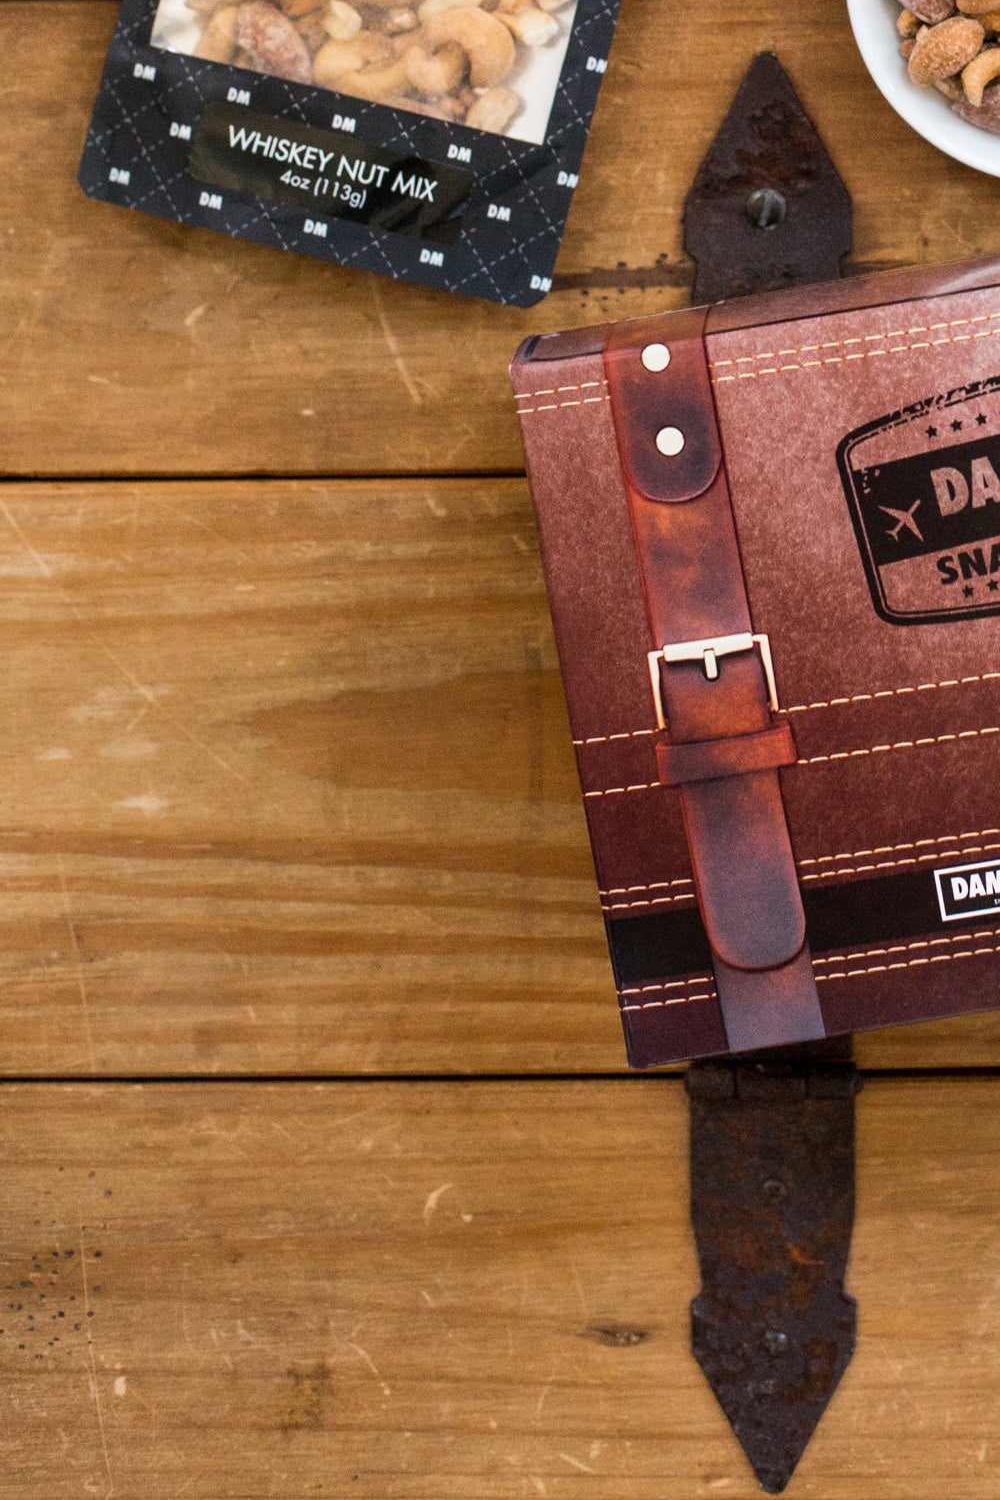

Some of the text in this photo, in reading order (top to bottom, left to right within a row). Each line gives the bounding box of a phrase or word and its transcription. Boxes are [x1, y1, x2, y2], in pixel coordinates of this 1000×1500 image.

[133, 63, 156, 82] DM
[227, 87, 251, 106] DM
[169, 122, 192, 140] DM
[332, 114, 356, 133] DM
[228, 124, 438, 202] WHISKEY NUT MIX
[448, 144, 472, 163] DM
[109, 167, 130, 186] DM
[280, 169, 367, 210] 4oz (113g)
[199, 191, 223, 210] DM
[487, 204, 511, 222] DM
[303, 219, 328, 237] DM
[419, 249, 444, 267] DM
